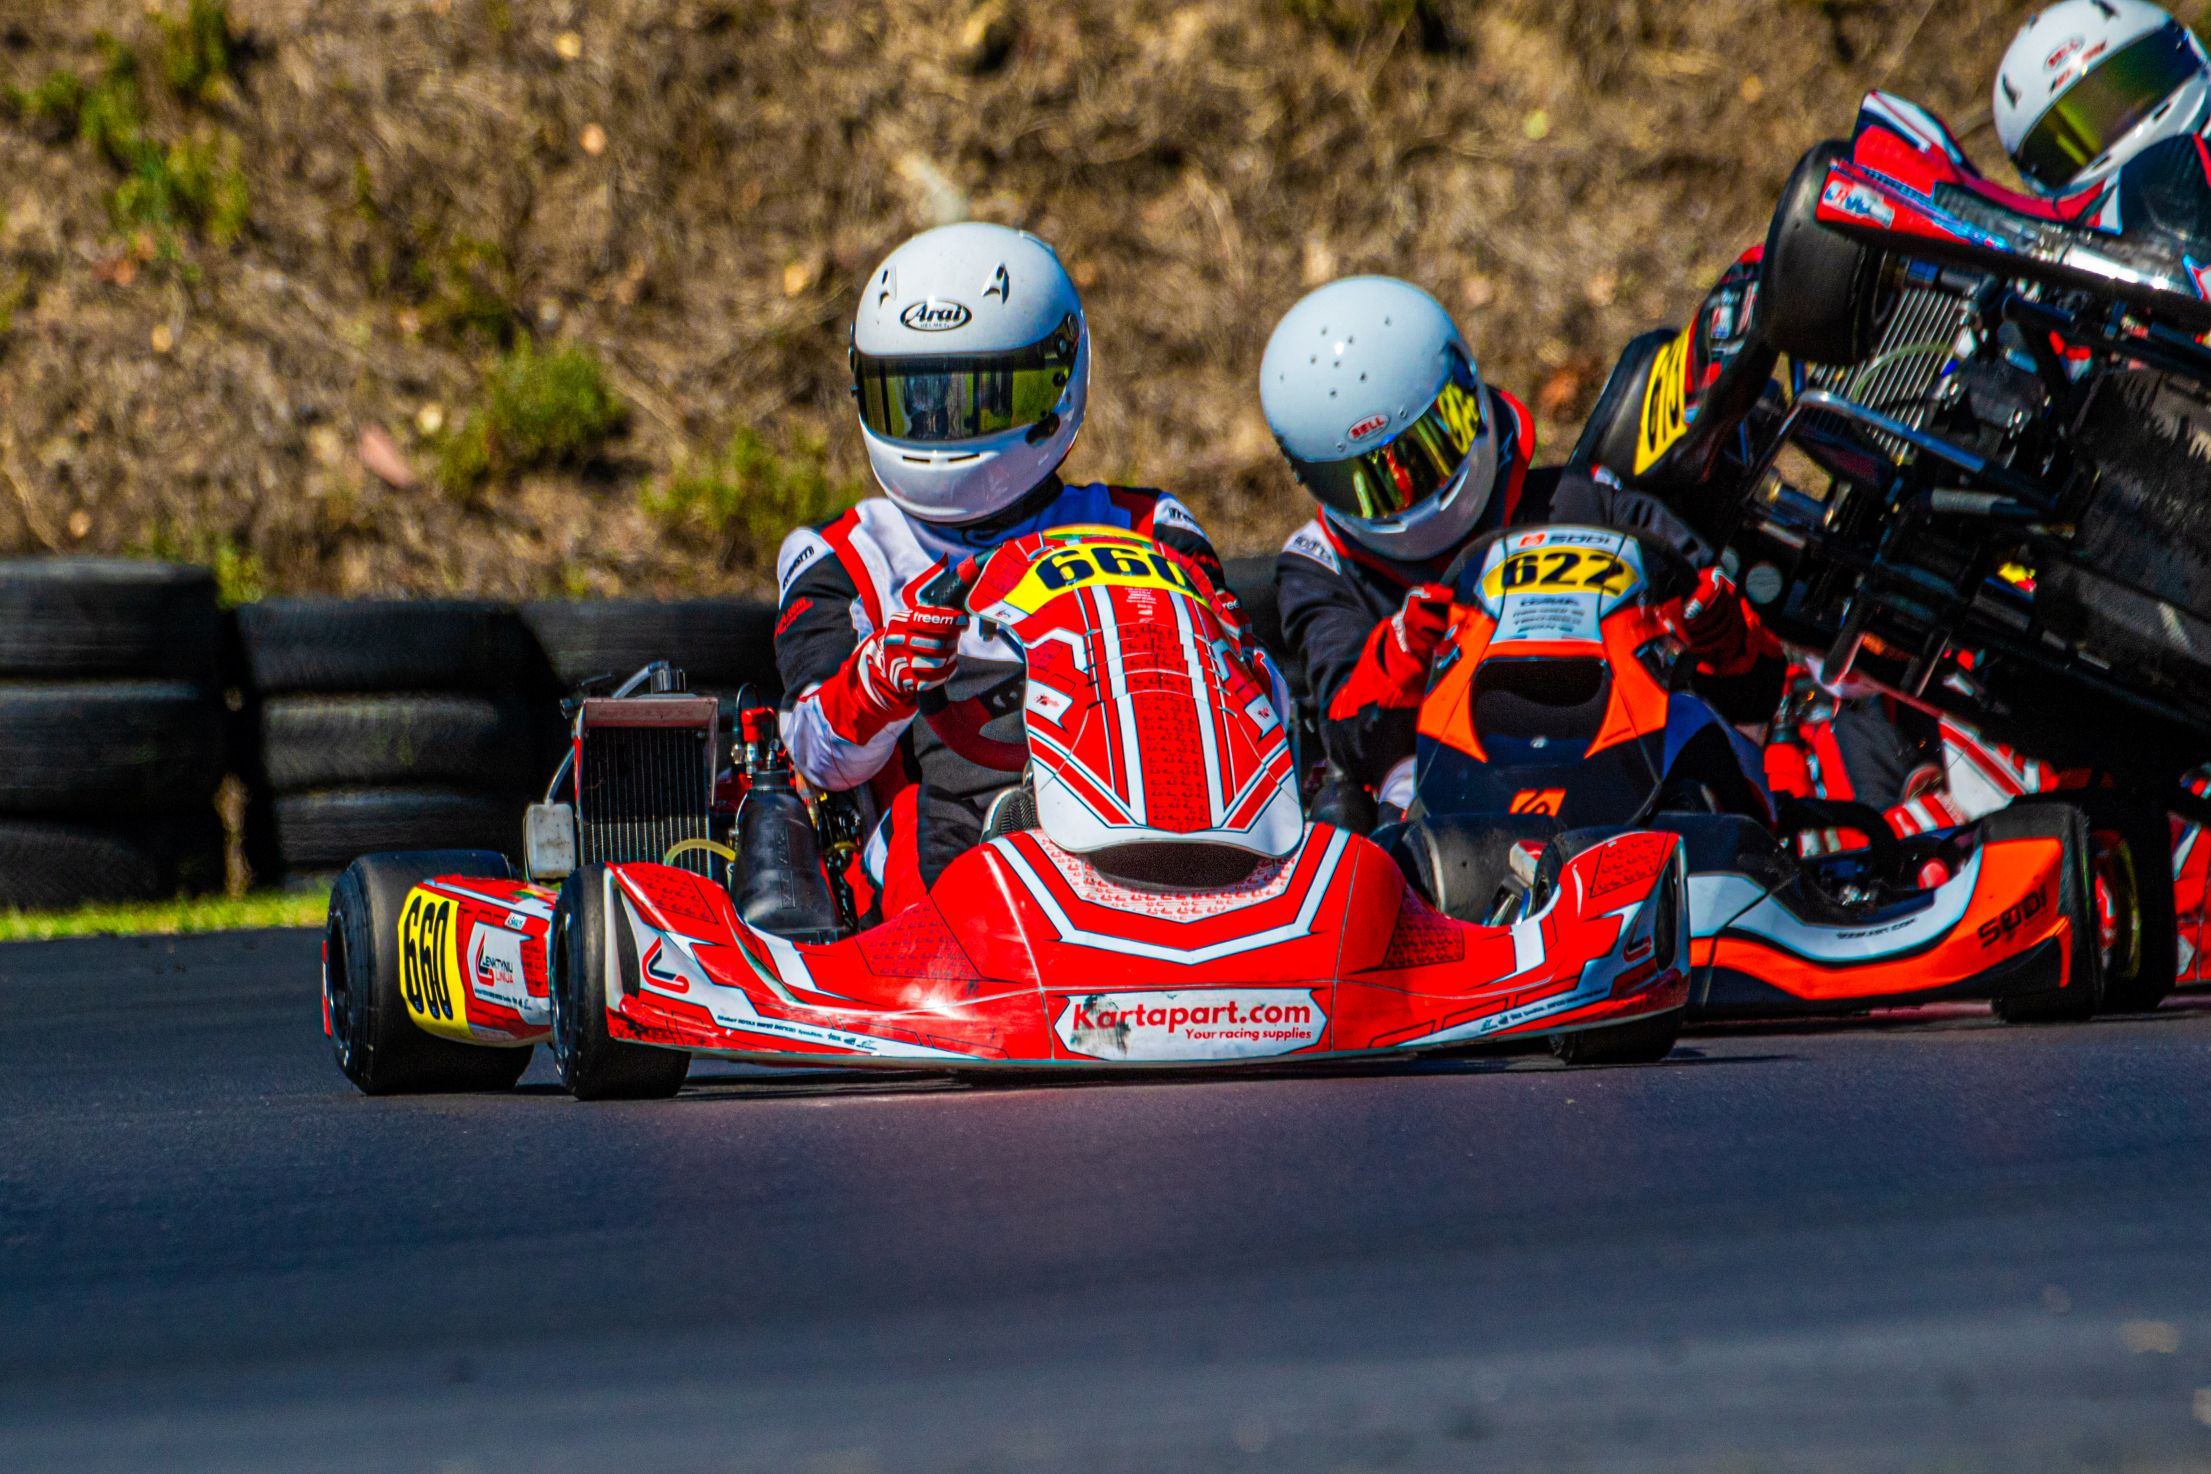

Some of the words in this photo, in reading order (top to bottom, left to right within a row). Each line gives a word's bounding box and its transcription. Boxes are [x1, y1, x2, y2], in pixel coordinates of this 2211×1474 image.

[904, 303, 962, 325] Arai
[1351, 416, 1385, 439] BELL
[1035, 547, 1200, 597] 660
[1502, 552, 1624, 597] 622
[912, 612, 954, 625] freem
[403, 895, 454, 1020] 660
[1073, 1001, 1311, 1034] Kartapart.com
[1185, 1028, 1218, 1040] Your
[1219, 1026, 1260, 1041] racing
[1262, 1024, 1312, 1041] supplies
